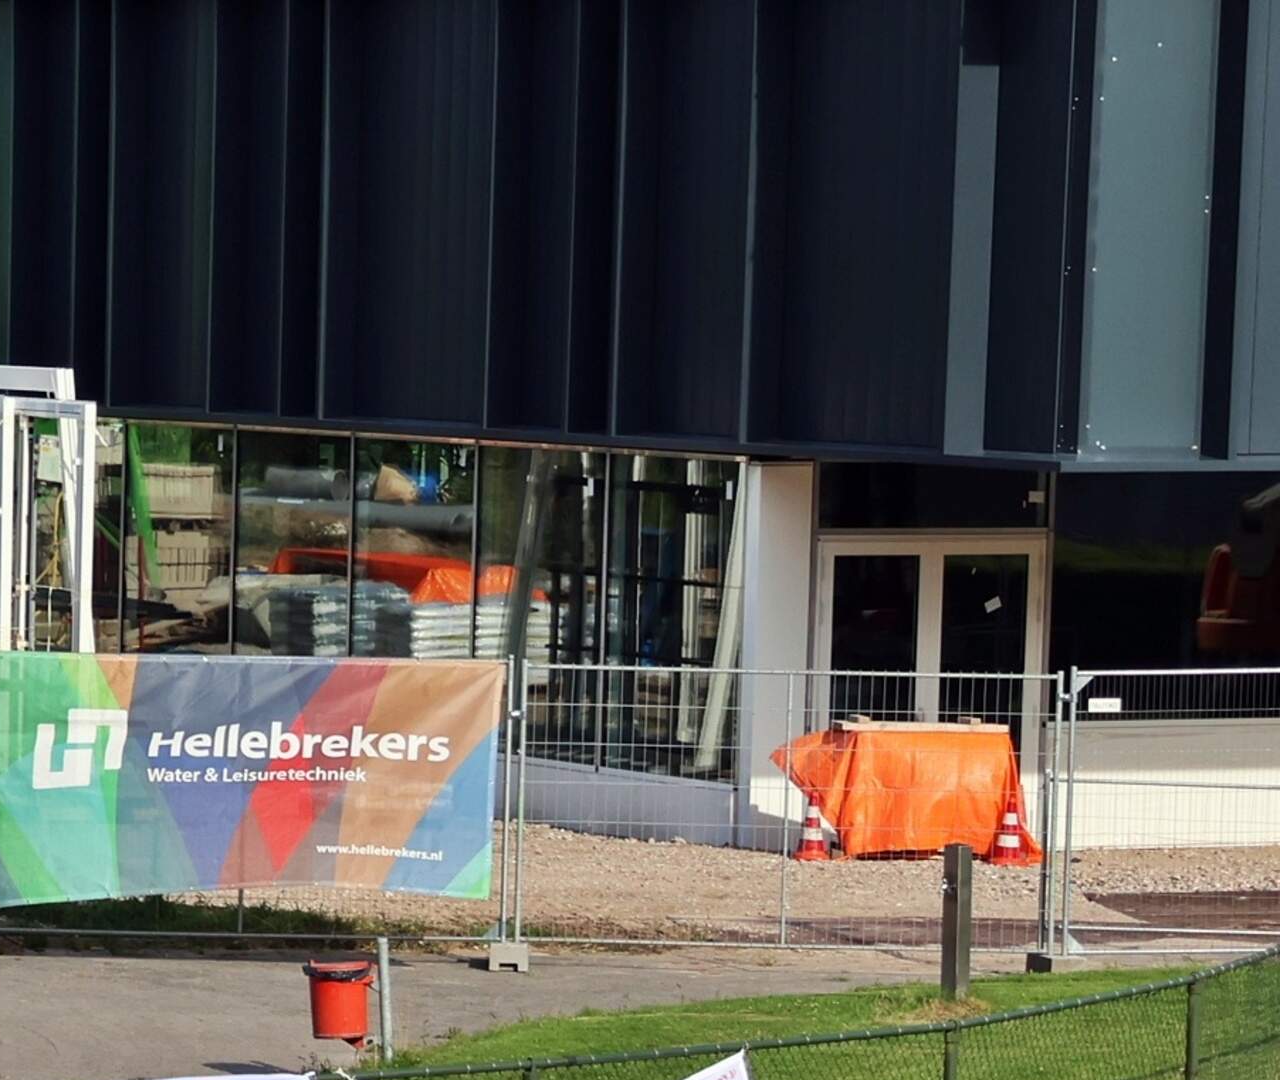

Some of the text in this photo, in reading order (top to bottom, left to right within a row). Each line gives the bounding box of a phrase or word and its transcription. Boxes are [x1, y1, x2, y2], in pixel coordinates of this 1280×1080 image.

[147, 721, 450, 761] Hellebrekers
[146, 766, 366, 782] Water & Leisuretechniek
[316, 843, 443, 861] www.hellebrekers.nl
